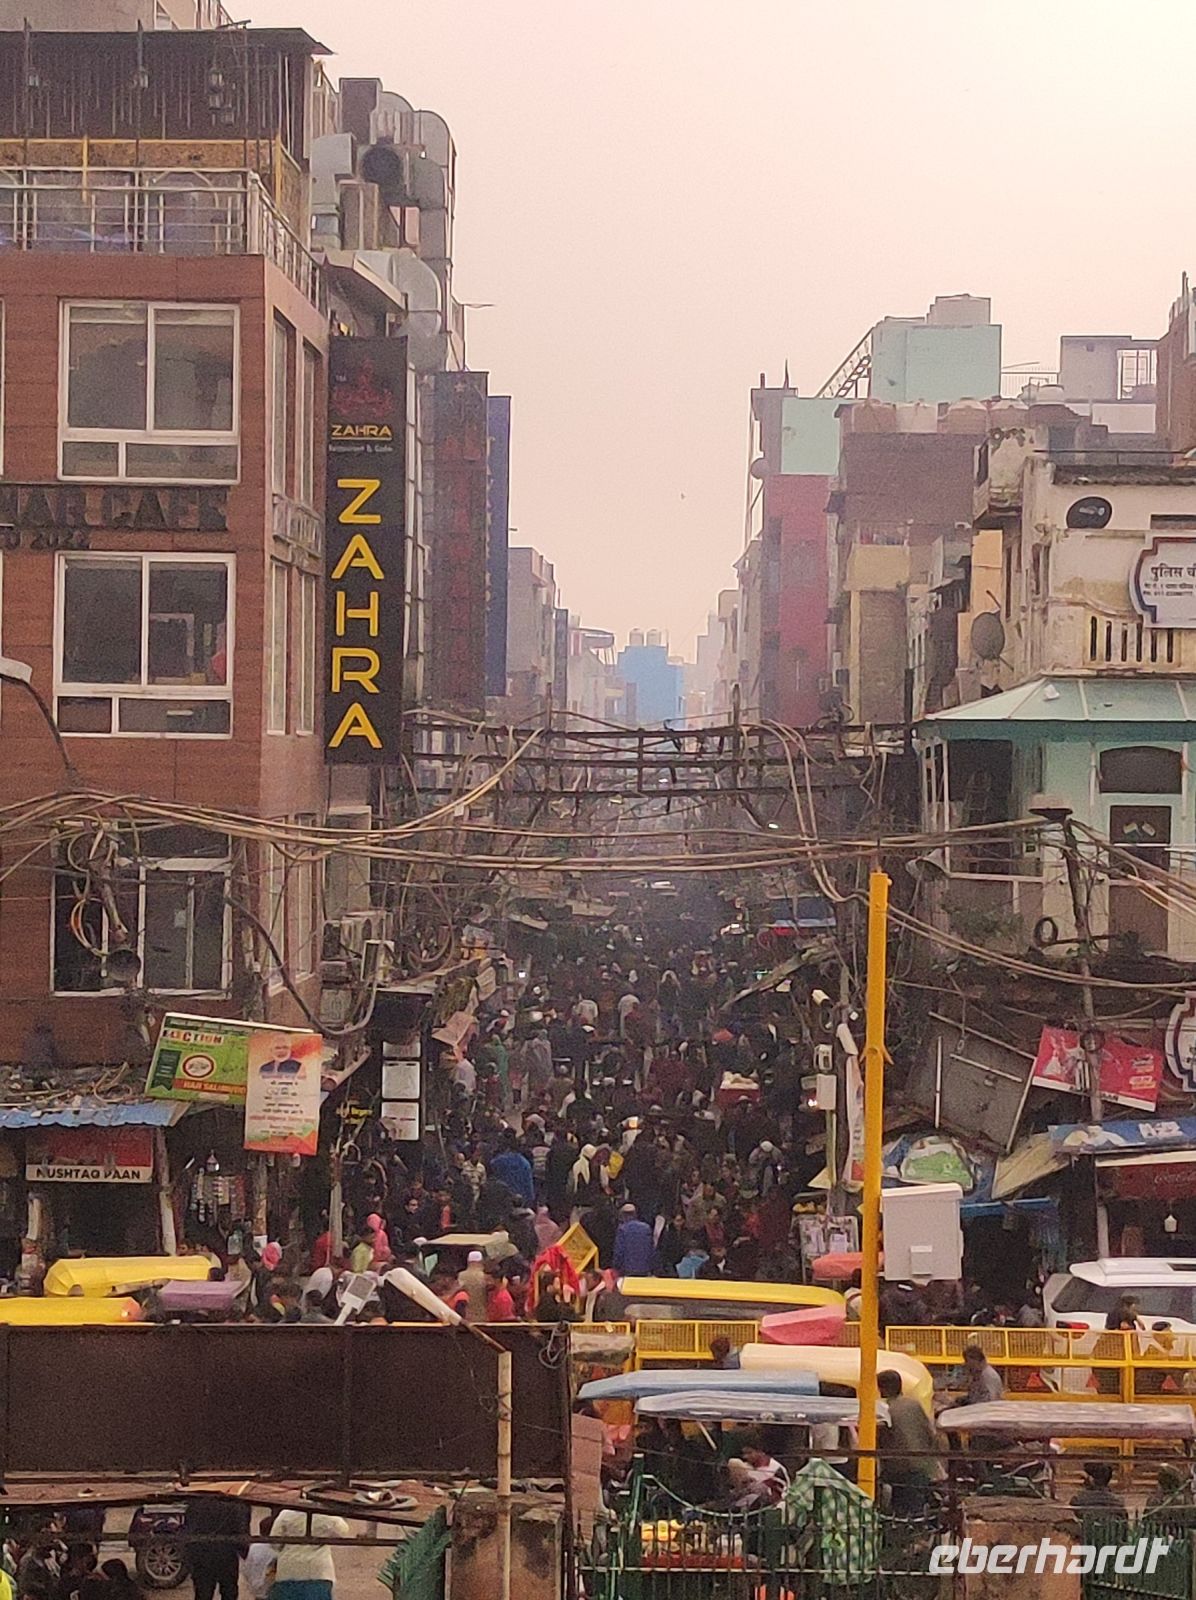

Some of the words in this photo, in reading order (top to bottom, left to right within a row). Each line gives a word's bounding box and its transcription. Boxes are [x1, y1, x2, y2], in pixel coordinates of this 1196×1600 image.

[331, 425, 392, 436] ZAHRA
[1151, 563, 1184, 581] पुलिस
[328, 479, 385, 749] ZAHRA
